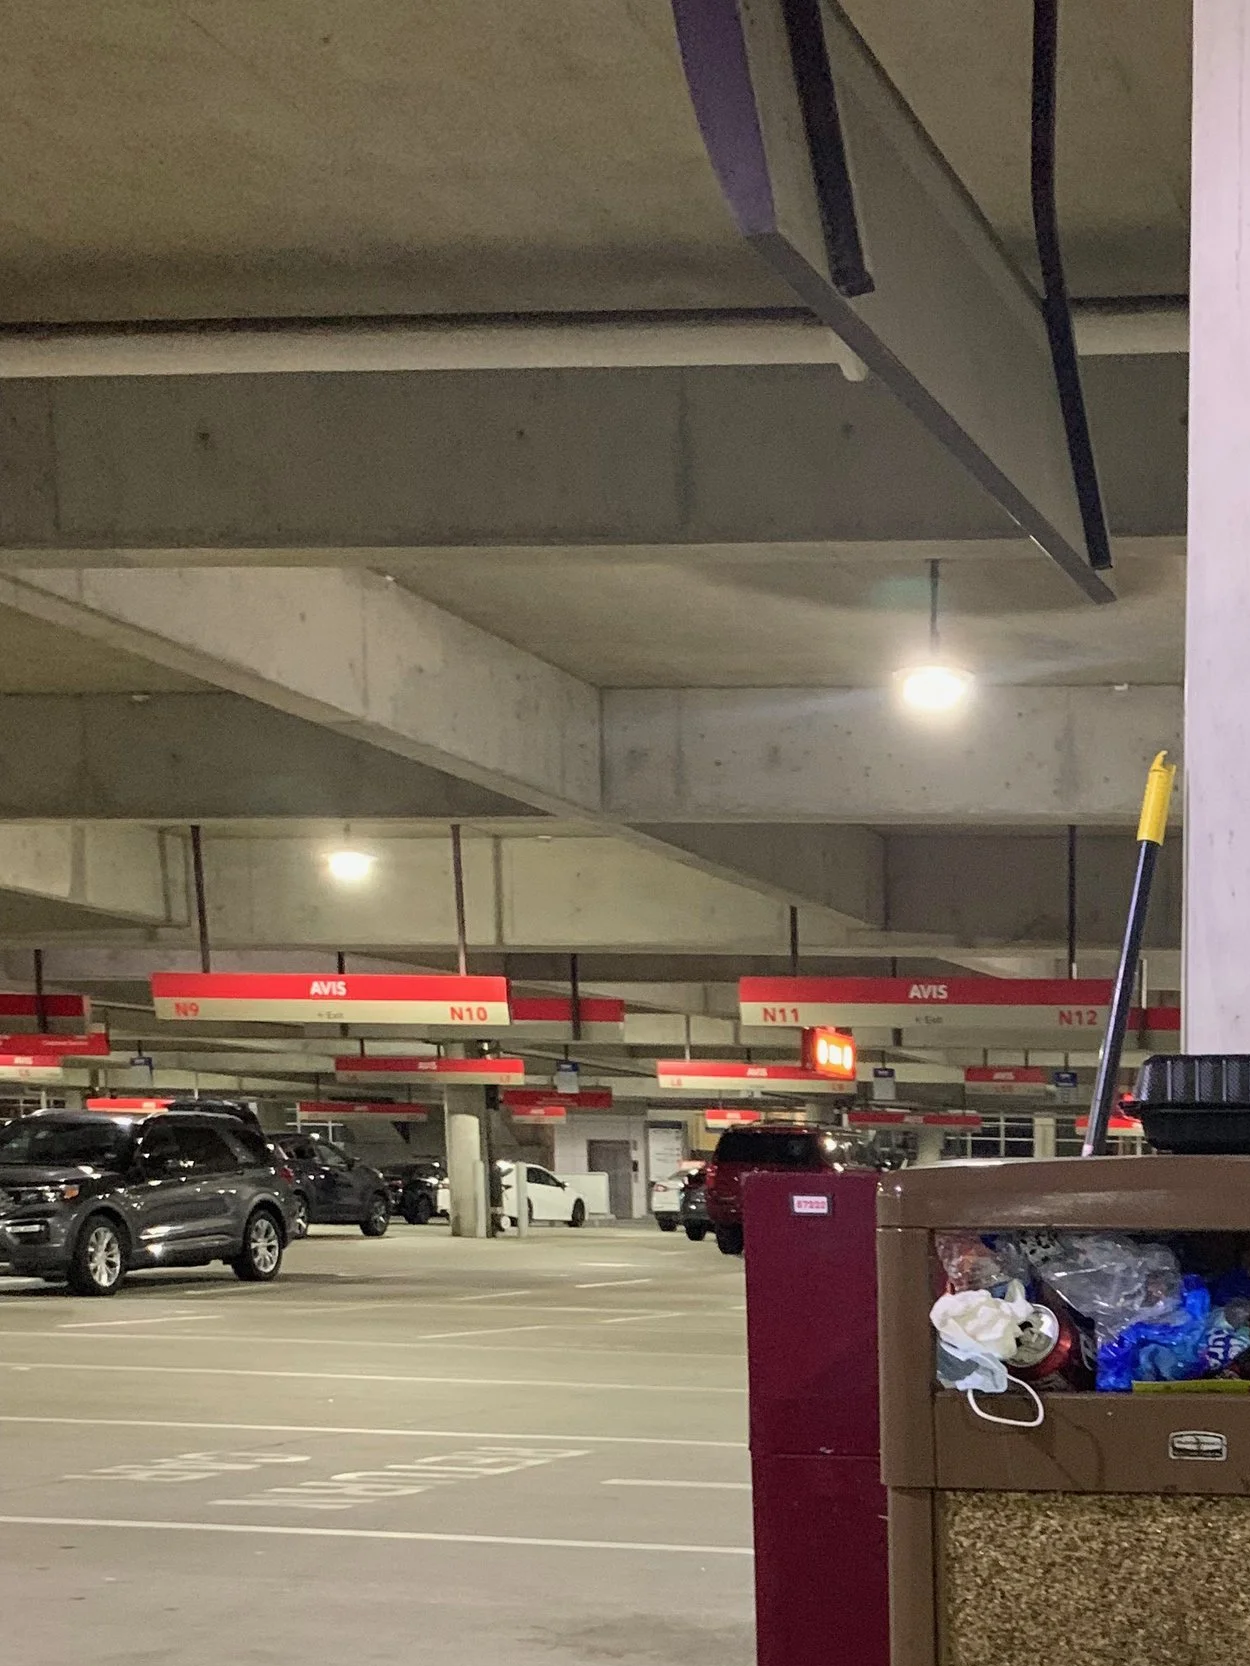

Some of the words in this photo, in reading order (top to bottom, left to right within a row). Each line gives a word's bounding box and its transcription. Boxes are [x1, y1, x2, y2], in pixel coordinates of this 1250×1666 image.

[310, 981, 347, 997] AVIS
[908, 984, 948, 1000] AVIS
[174, 1002, 199, 1017] N9
[450, 1006, 488, 1021] N10
[763, 1007, 800, 1023] N11
[1059, 1010, 1098, 1026] N12
[62, 1450, 312, 1482] CAR
[206, 1446, 593, 1511] RETURN
